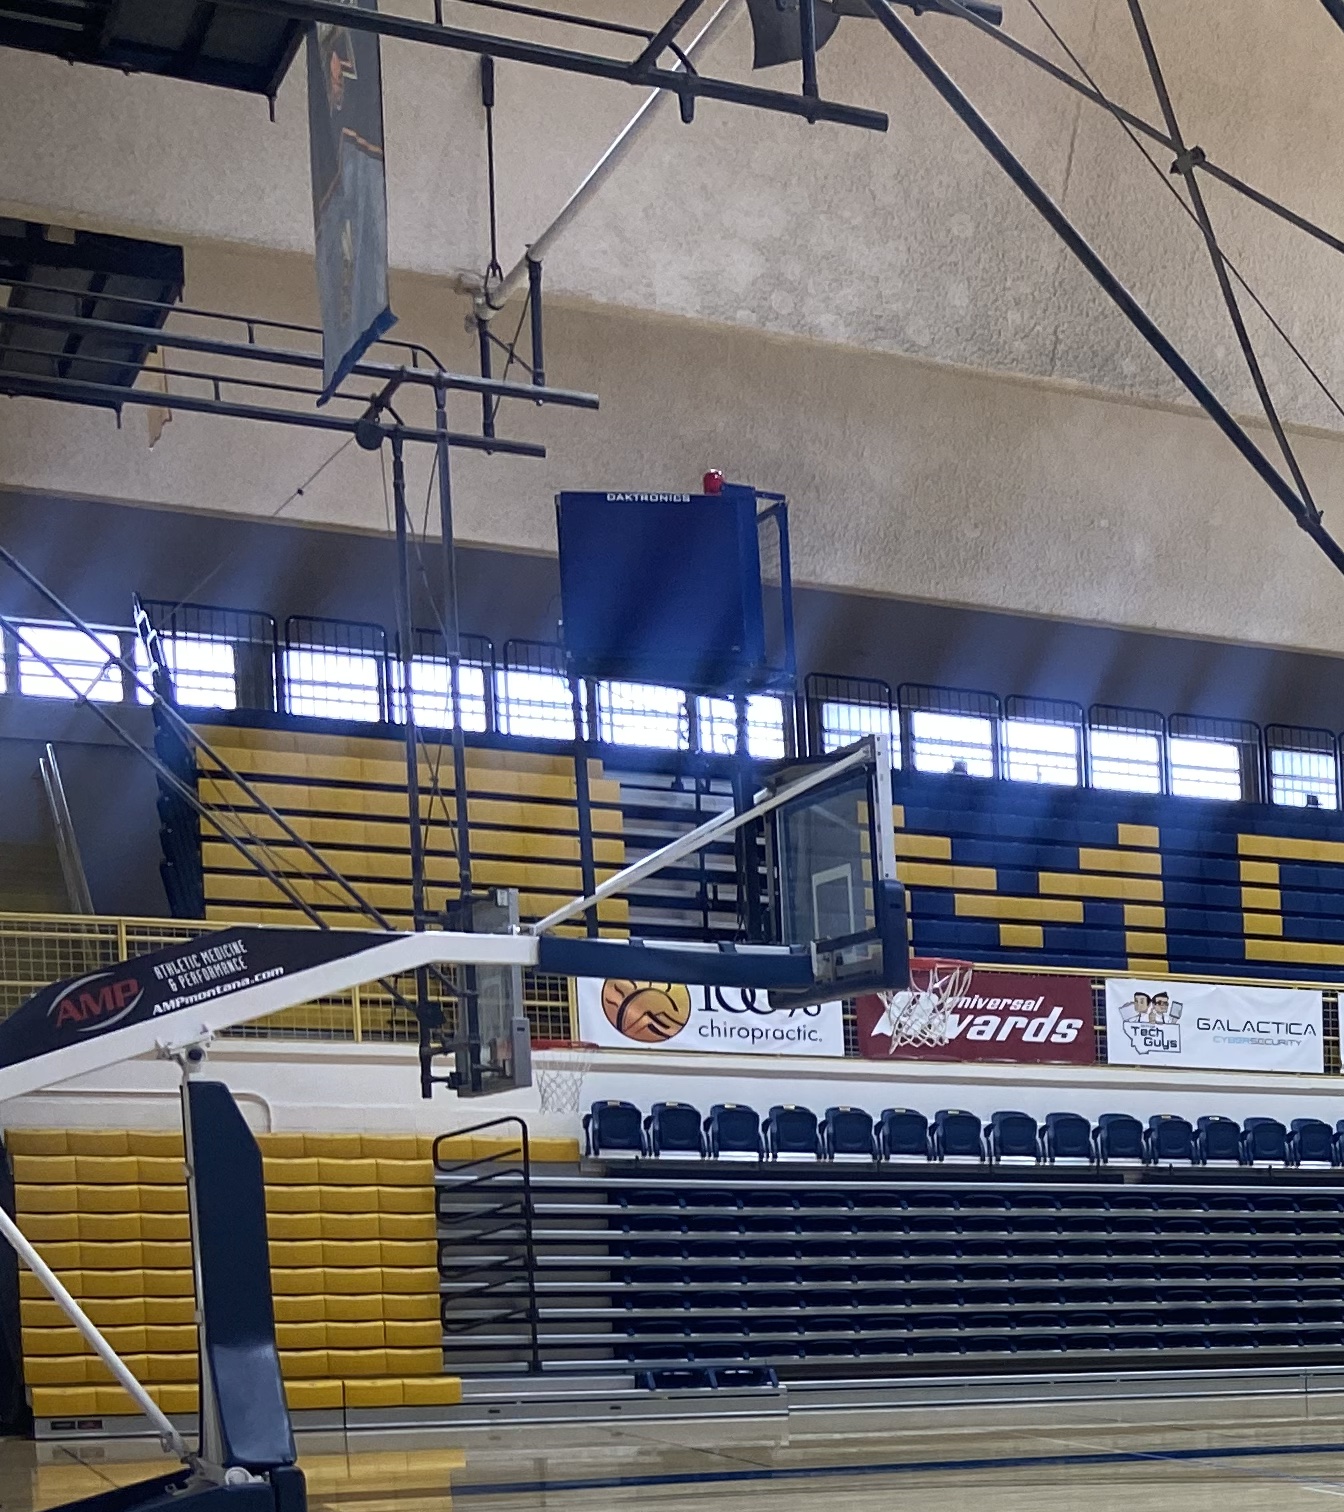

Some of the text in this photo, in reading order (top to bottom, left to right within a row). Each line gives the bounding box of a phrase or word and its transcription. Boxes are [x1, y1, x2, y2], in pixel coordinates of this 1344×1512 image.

[606, 492, 691, 503] DAKTRONICS
[153, 939, 248, 980] ATHLETIC MEDICINE
[179, 956, 248, 987] PERFORMANCE
[152, 966, 285, 1015] AMPmontana.com
[55, 978, 140, 1029] AMP
[948, 995, 1045, 1012] niversal
[1131, 1025, 1164, 1038] Tech
[1196, 1017, 1317, 1037] GALACTICA
[1144, 1036, 1178, 1050] Guys
[1213, 1035, 1302, 1046] CYBERSECURITY
